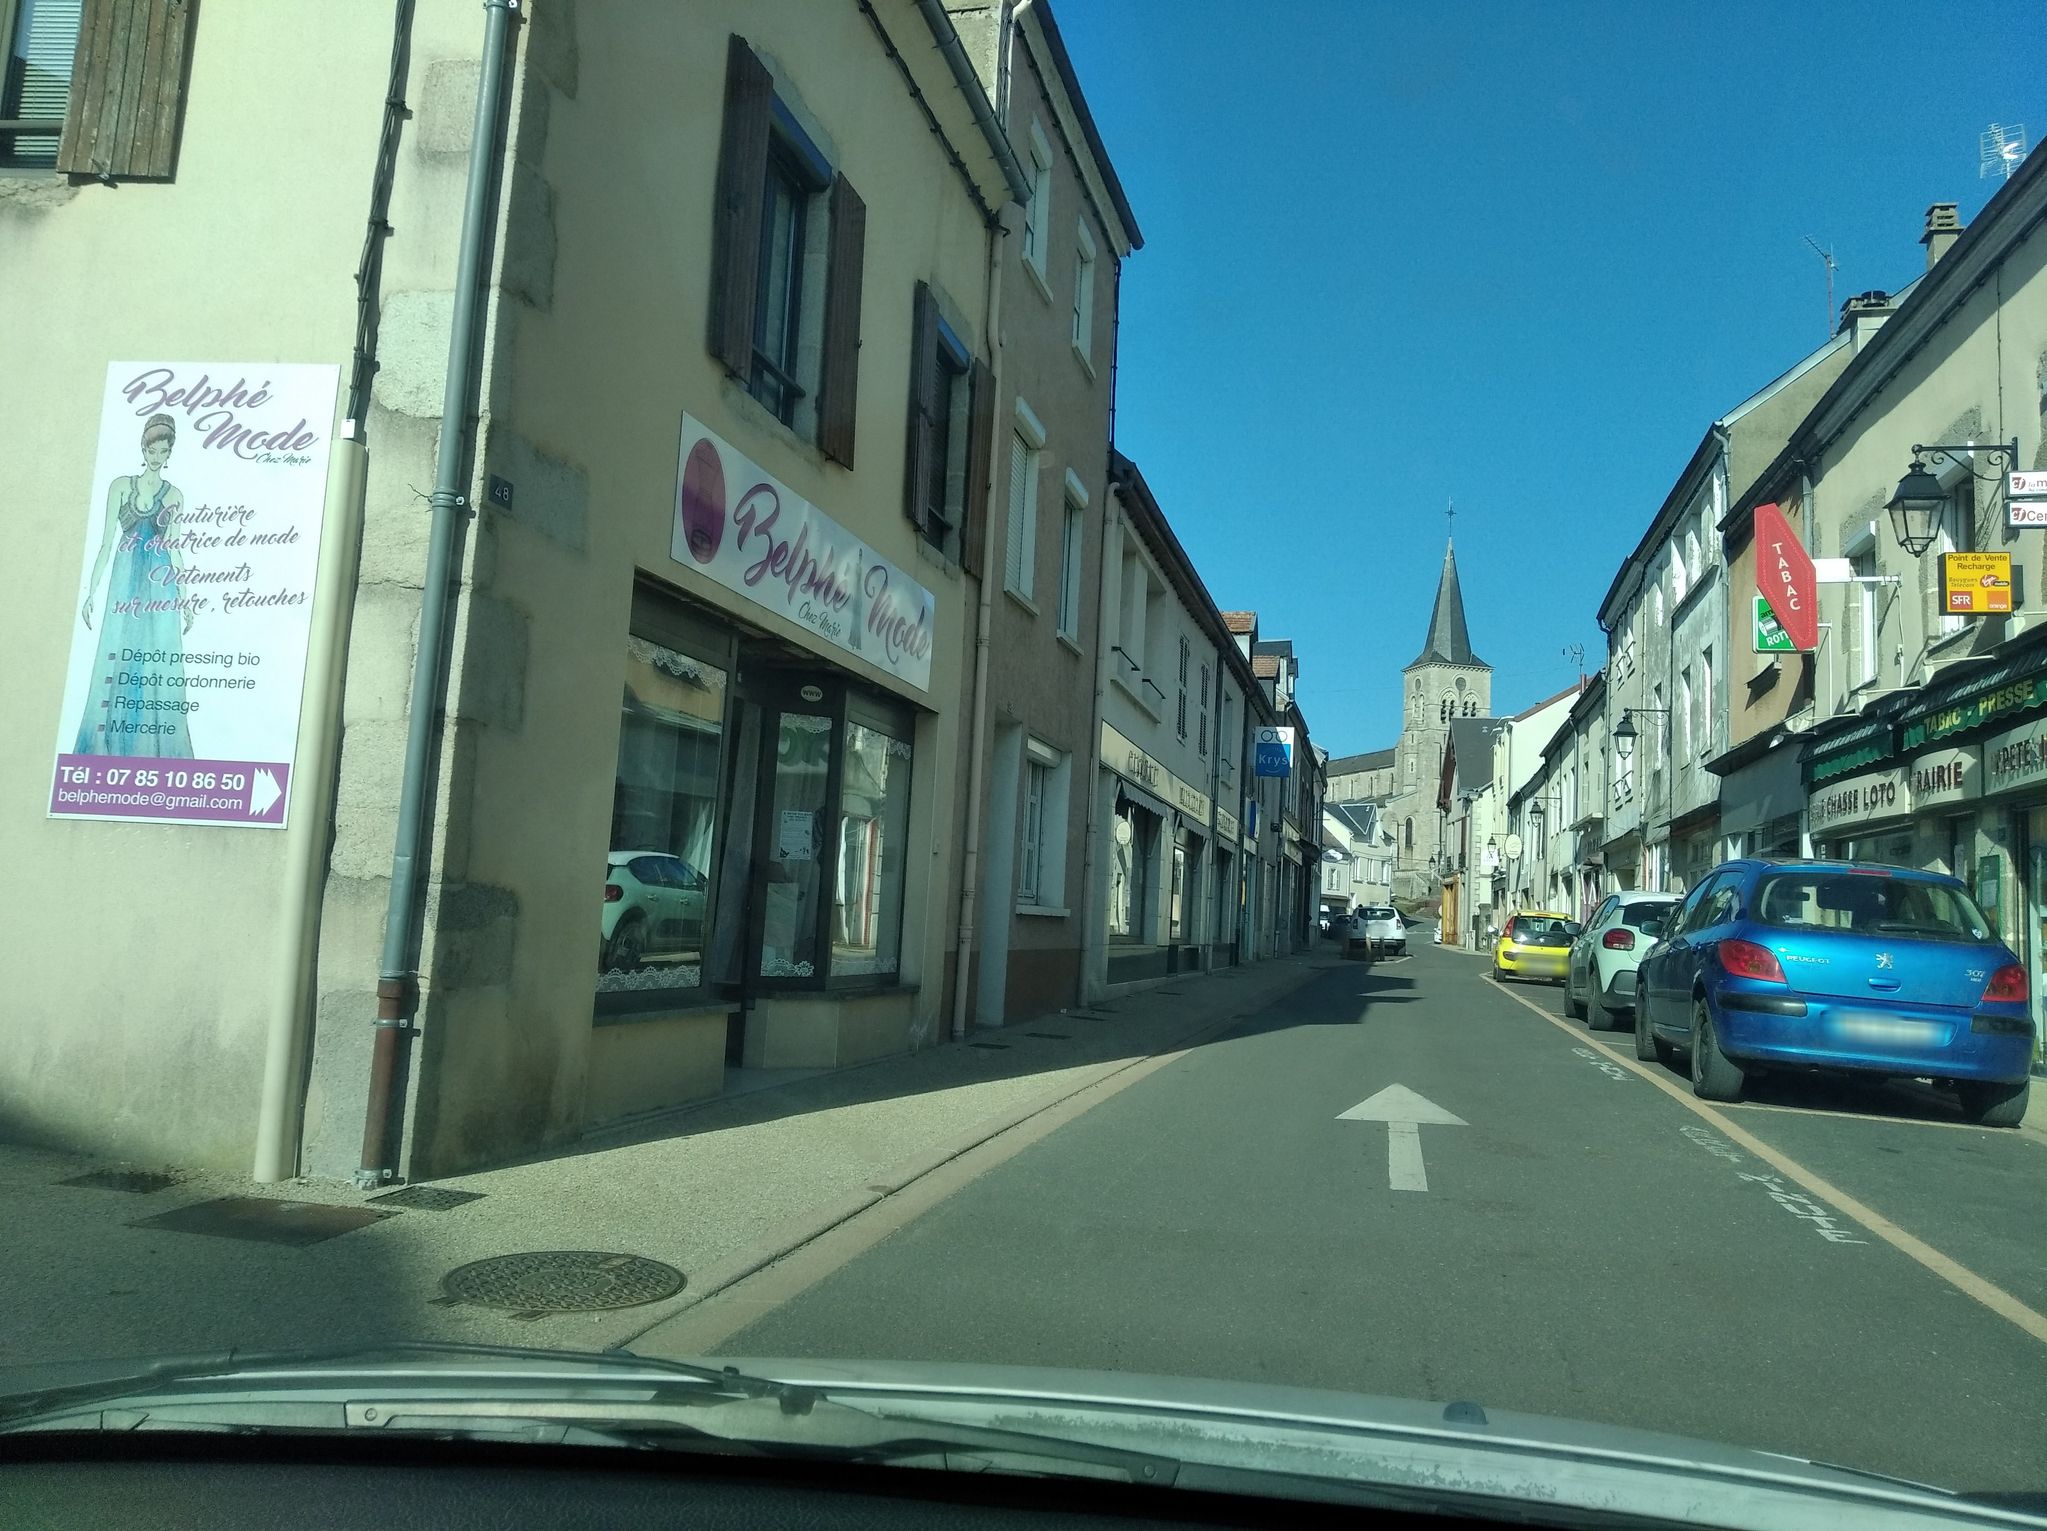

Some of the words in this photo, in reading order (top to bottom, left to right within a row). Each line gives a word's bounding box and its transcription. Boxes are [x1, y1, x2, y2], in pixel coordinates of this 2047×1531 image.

[122, 368, 274, 416] Belphé
[193, 410, 320, 460] Mode
[256, 452, 280, 464] Chez
[281, 452, 312, 467] Marie
[494, 485, 509, 501] 48
[156, 501, 257, 528] Couturière
[117, 532, 144, 553] et
[224, 528, 249, 547] de
[249, 525, 301, 547] mode
[1947, 554, 1968, 562] Point
[1971, 554, 1981, 562] de
[1984, 554, 2008, 562] Vente
[1957, 562, 1996, 572] Recharge
[1771, 542, 1801, 611] TABAC
[111, 597, 142, 620] sur
[222, 588, 309, 614] retouches
[1951, 595, 1971, 605] SFR
[798, 599, 817, 624] Chez
[819, 611, 842, 638] Marie
[864, 565, 930, 665] Mode
[121, 648, 167, 666] Dépôt
[169, 650, 234, 669] pressing
[237, 651, 261, 666] bio
[118, 671, 164, 689] Dépôt
[166, 674, 256, 690] cordonnerie
[114, 695, 200, 715] Repassage
[1924, 707, 1961, 735] TABAC
[1979, 680, 2034, 716] PRESSE
[110, 719, 177, 735] Mercerie
[1258, 754, 1288, 767] Krys
[60, 766, 90, 784] Tél
[106, 768, 132, 786] 07
[134, 769, 159, 787] 85
[165, 770, 188, 788] 10
[191, 771, 216, 790] 86
[220, 773, 245, 791] 50
[57, 788, 243, 810] belphemode@gmail.com
[1827, 789, 1858, 815] CHASSE
[1863, 781, 1895, 810] LOTO
[1964, 969, 1985, 978] 307
